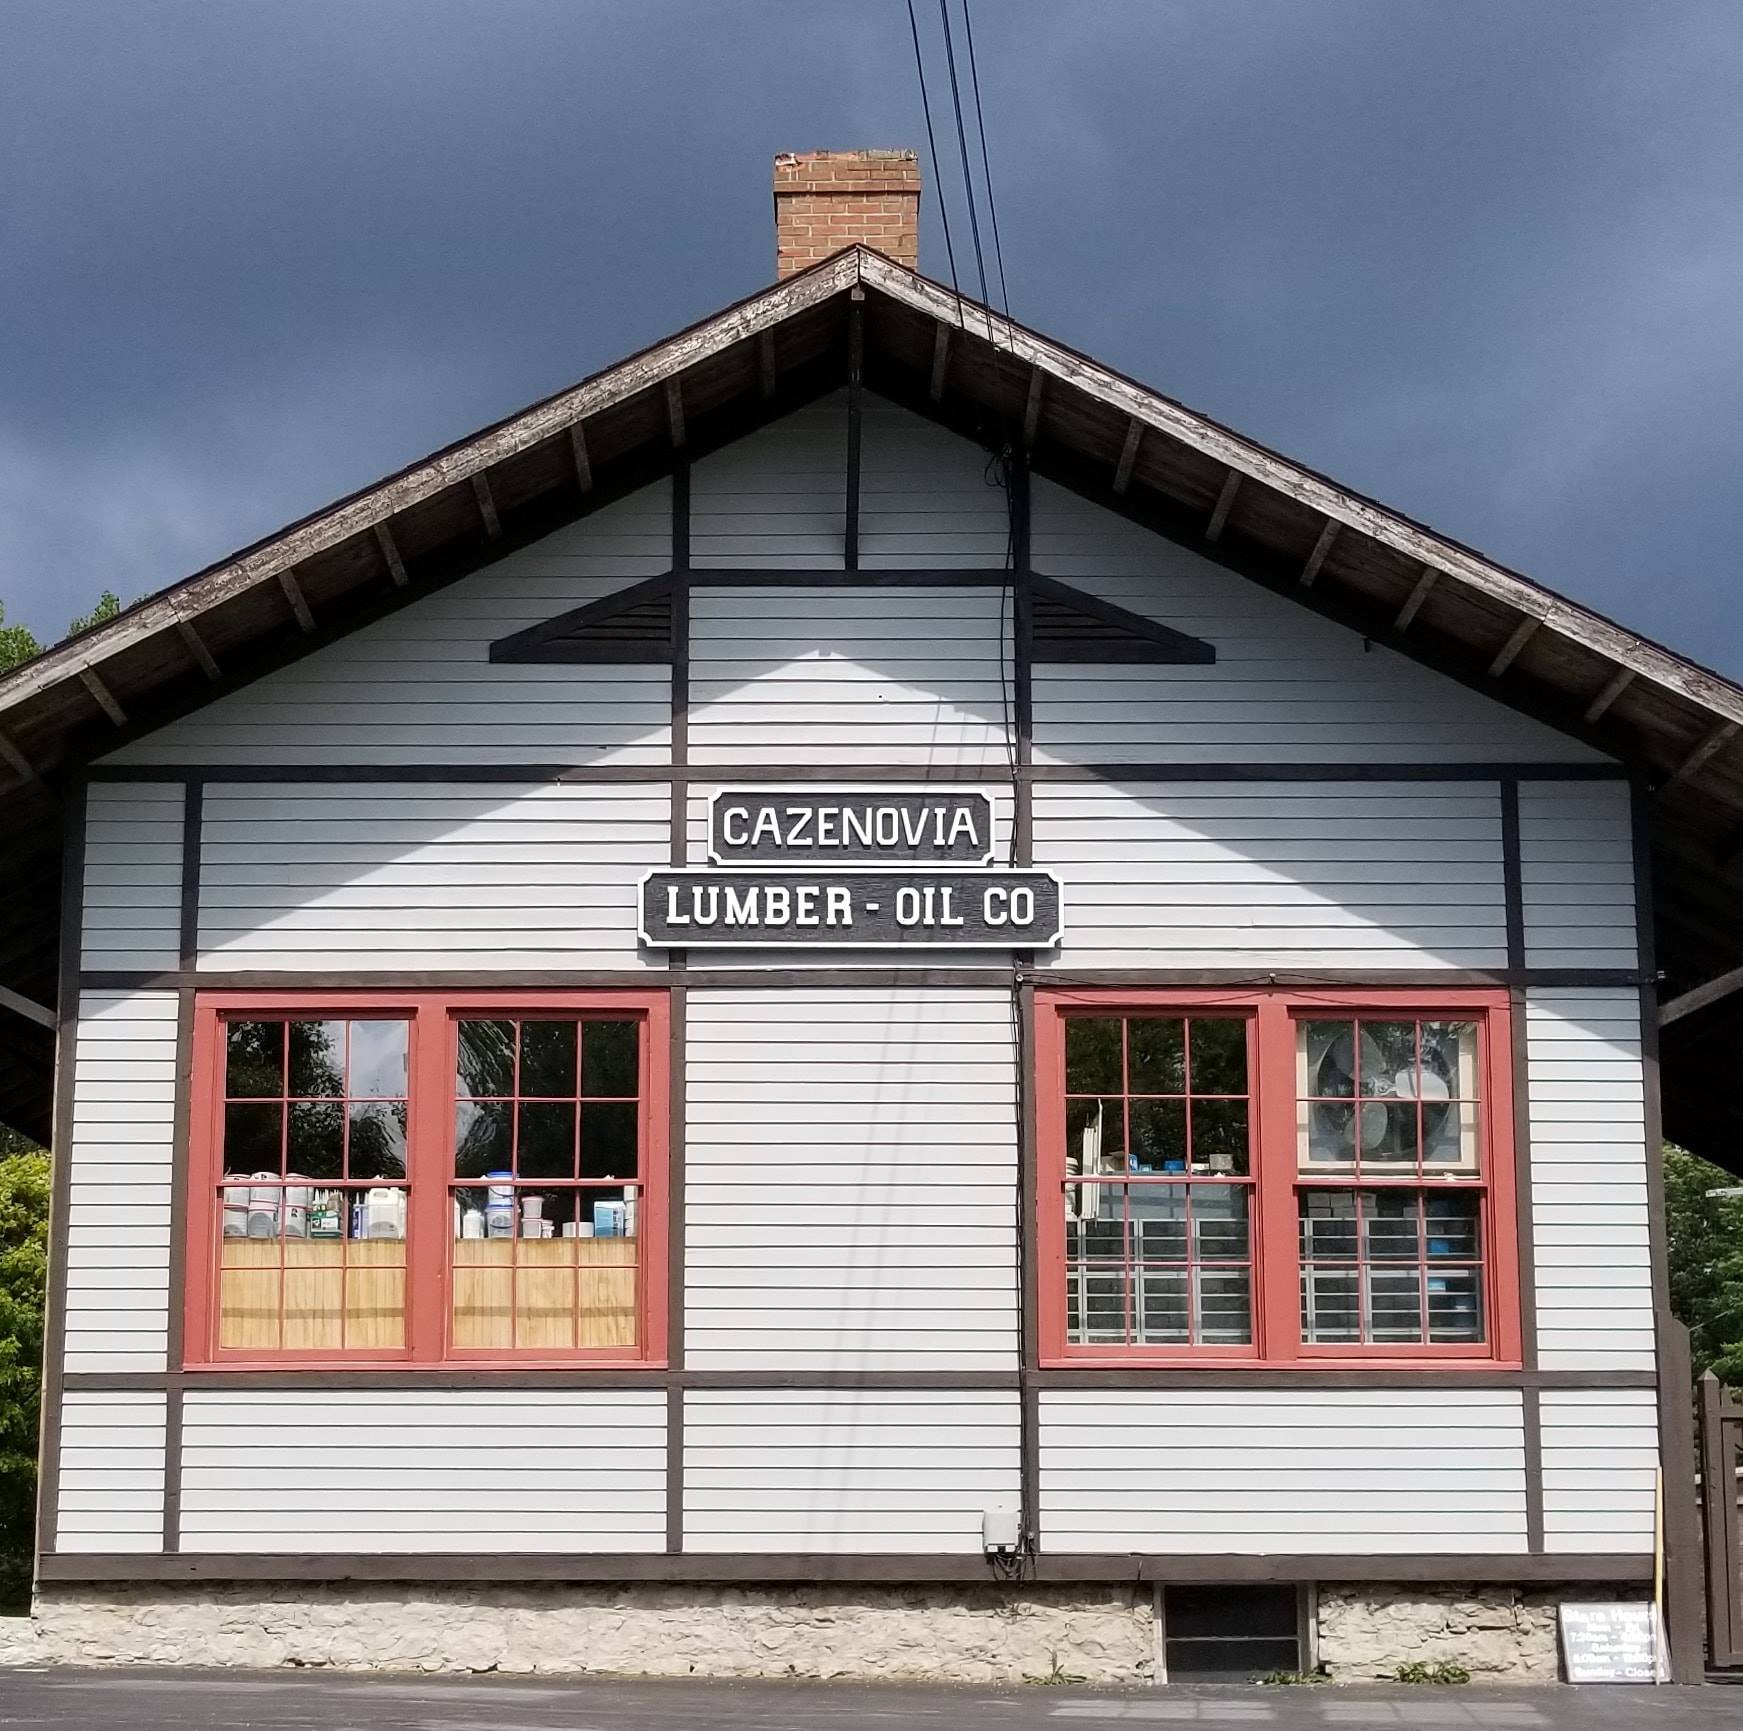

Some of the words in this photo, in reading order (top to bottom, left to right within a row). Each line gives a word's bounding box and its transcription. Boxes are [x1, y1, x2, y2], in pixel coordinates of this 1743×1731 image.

[722, 806, 980, 847] CAZENOVIA
[666, 885, 854, 926] LUMBER
[865, 902, 881, 912] -
[895, 886, 965, 926] OIL
[982, 886, 1035, 926] CO
[1564, 1609, 1606, 1623] Store
[1611, 1608, 1656, 1623] Hours
[1592, 1643, 1641, 1654] Saturday
[1574, 1667, 1615, 1678] Sunday
